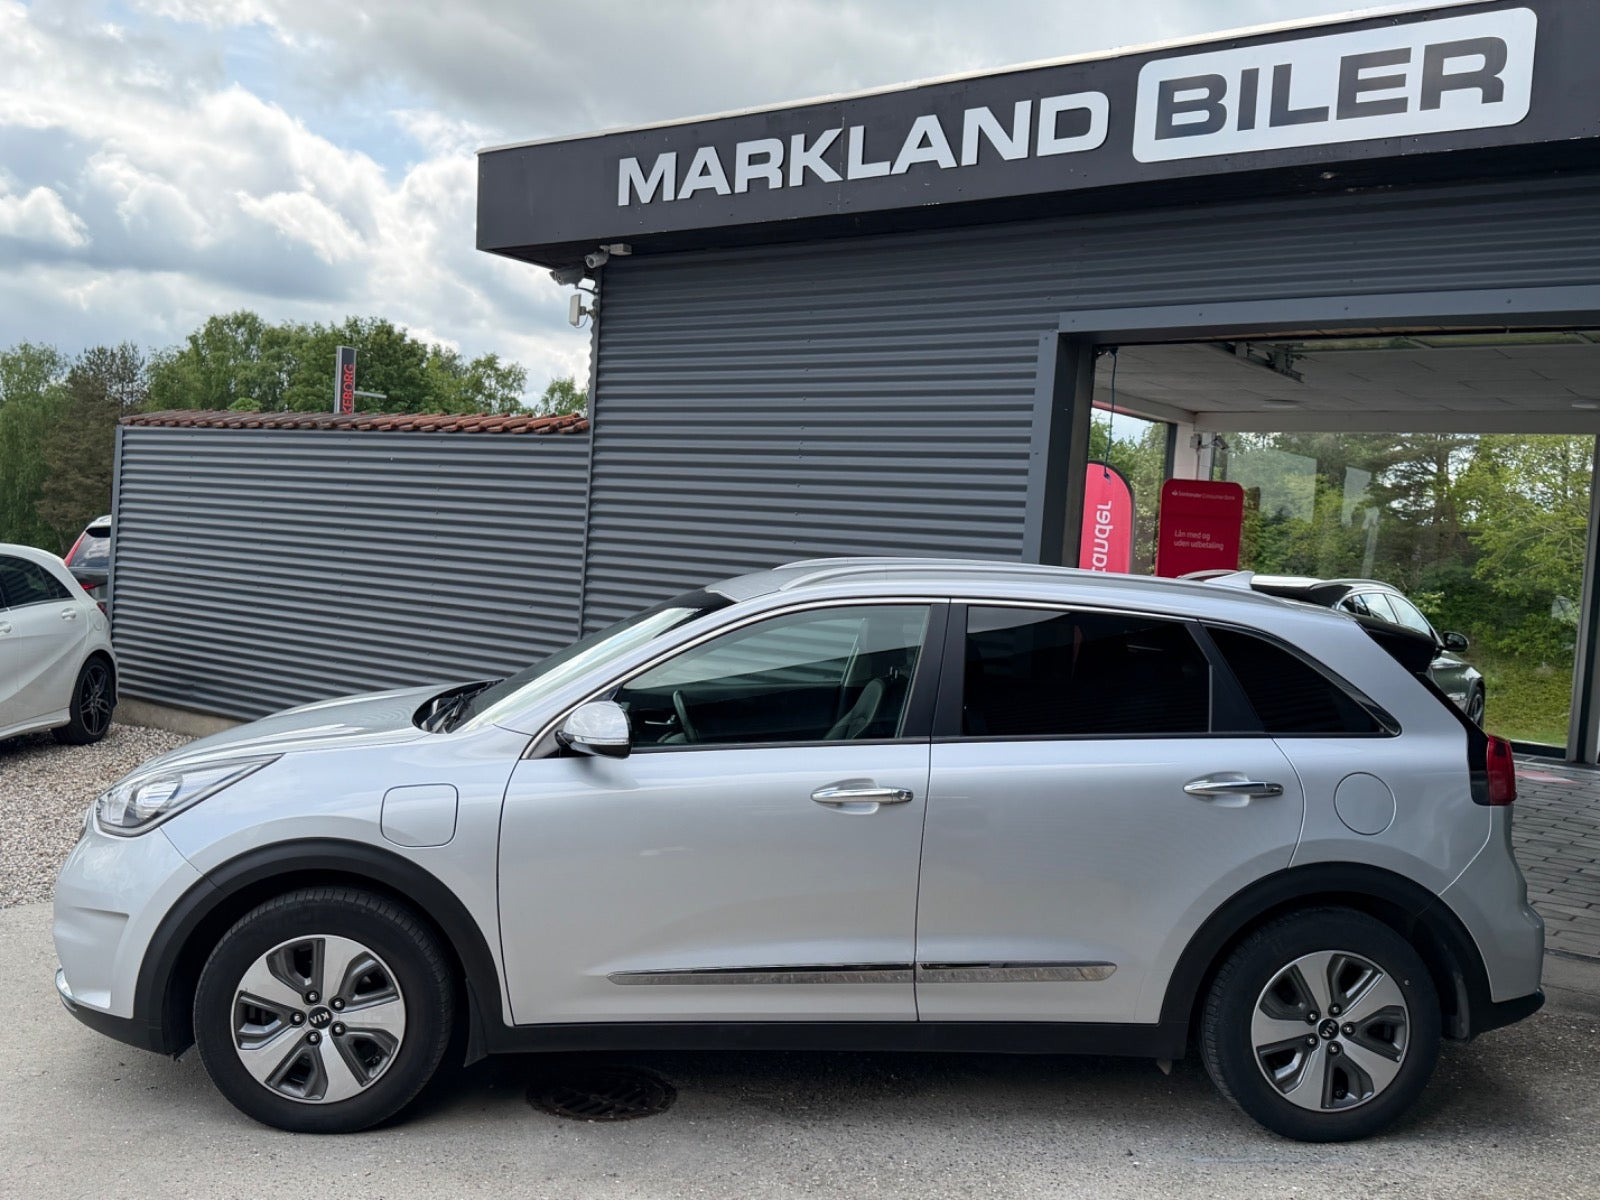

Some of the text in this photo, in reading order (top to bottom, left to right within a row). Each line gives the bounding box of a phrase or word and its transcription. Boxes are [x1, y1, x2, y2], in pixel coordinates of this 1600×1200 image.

[618, 36, 1508, 206] MARKLAND BILER
[1187, 531, 1202, 539] med
[1202, 533, 1210, 541] og
[1173, 539, 1190, 547] uden
[310, 1011, 330, 1024] KIA
